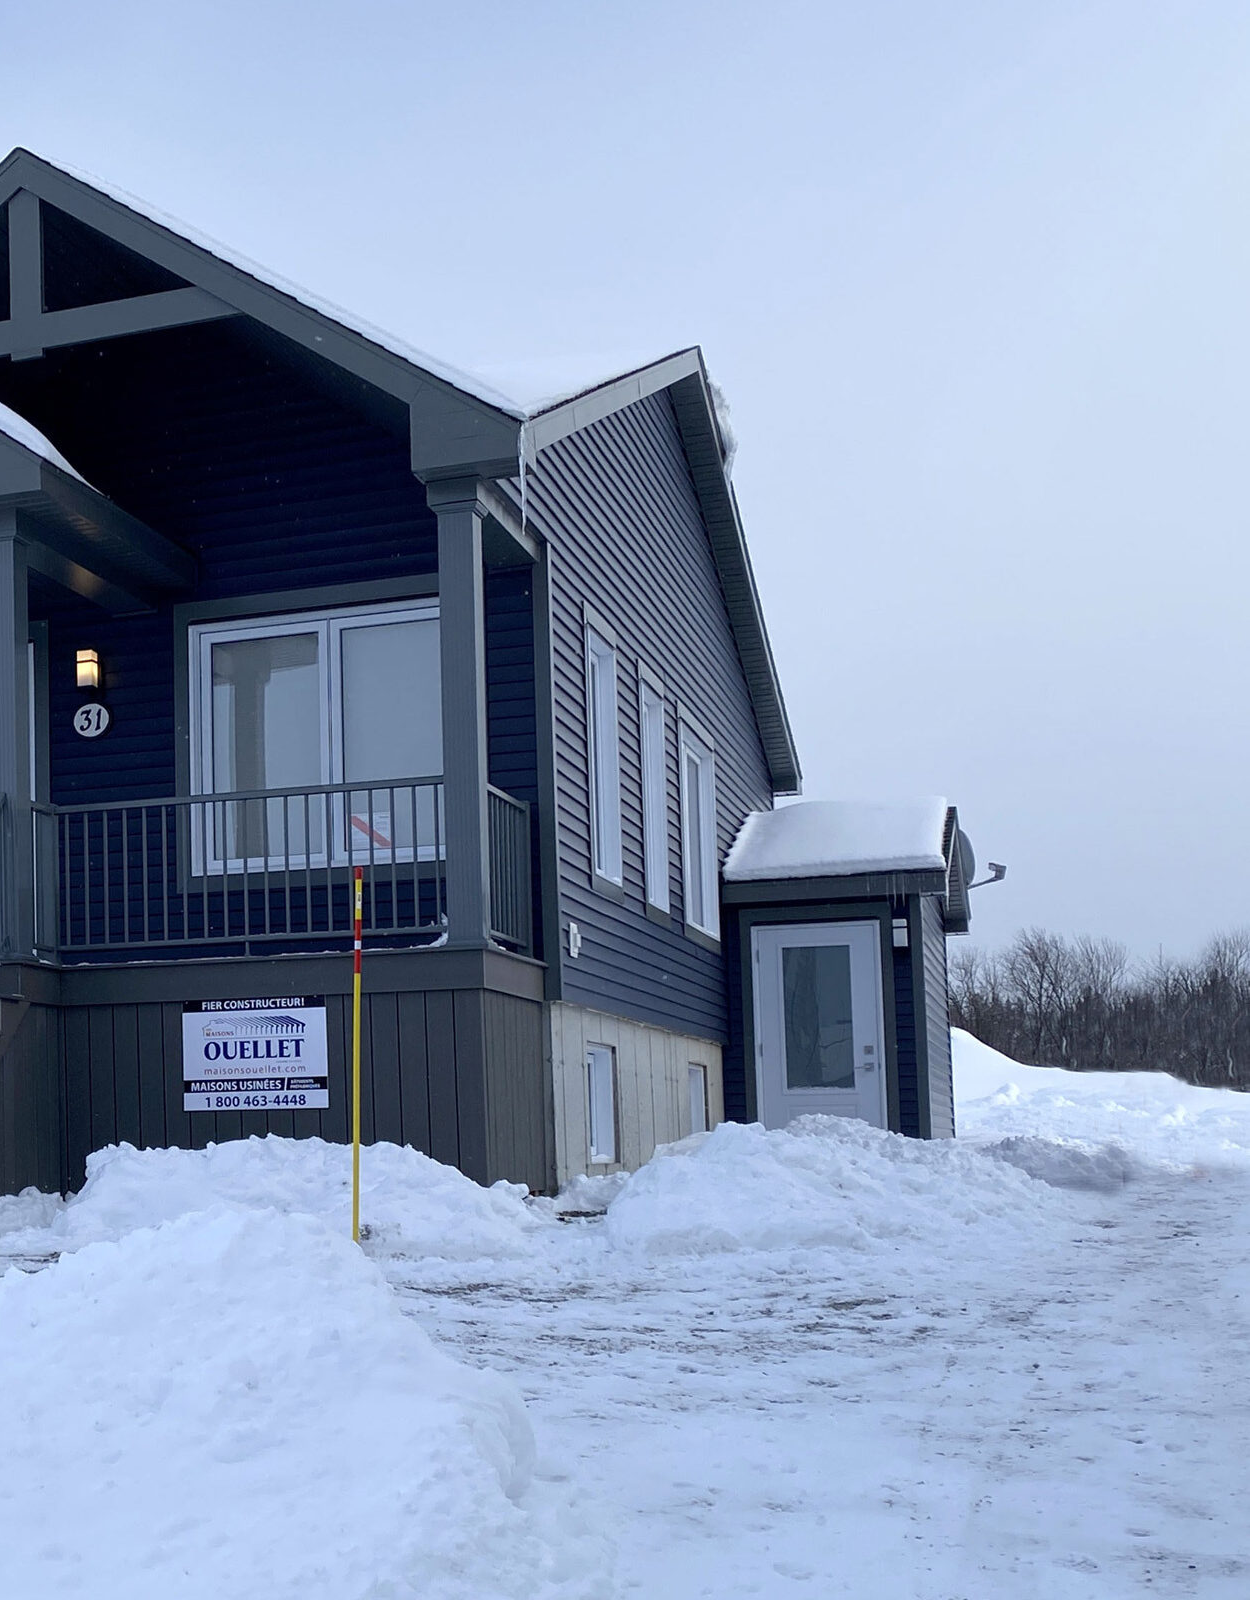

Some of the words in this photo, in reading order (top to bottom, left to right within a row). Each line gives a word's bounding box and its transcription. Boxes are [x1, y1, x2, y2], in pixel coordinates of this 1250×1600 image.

[79, 708, 102, 731] 31
[201, 1001, 223, 1011] FIER
[223, 997, 305, 1009] CONSTRUCTEUR!
[203, 1038, 305, 1061] OUELLET
[203, 1064, 307, 1076] maisonsouellet.com
[190, 1081, 238, 1092] MAISONS
[239, 1078, 282, 1091] USINÉES
[205, 1097, 211, 1108] 1
[215, 1096, 241, 1108] 800
[243, 1094, 307, 1107] 463-4448
